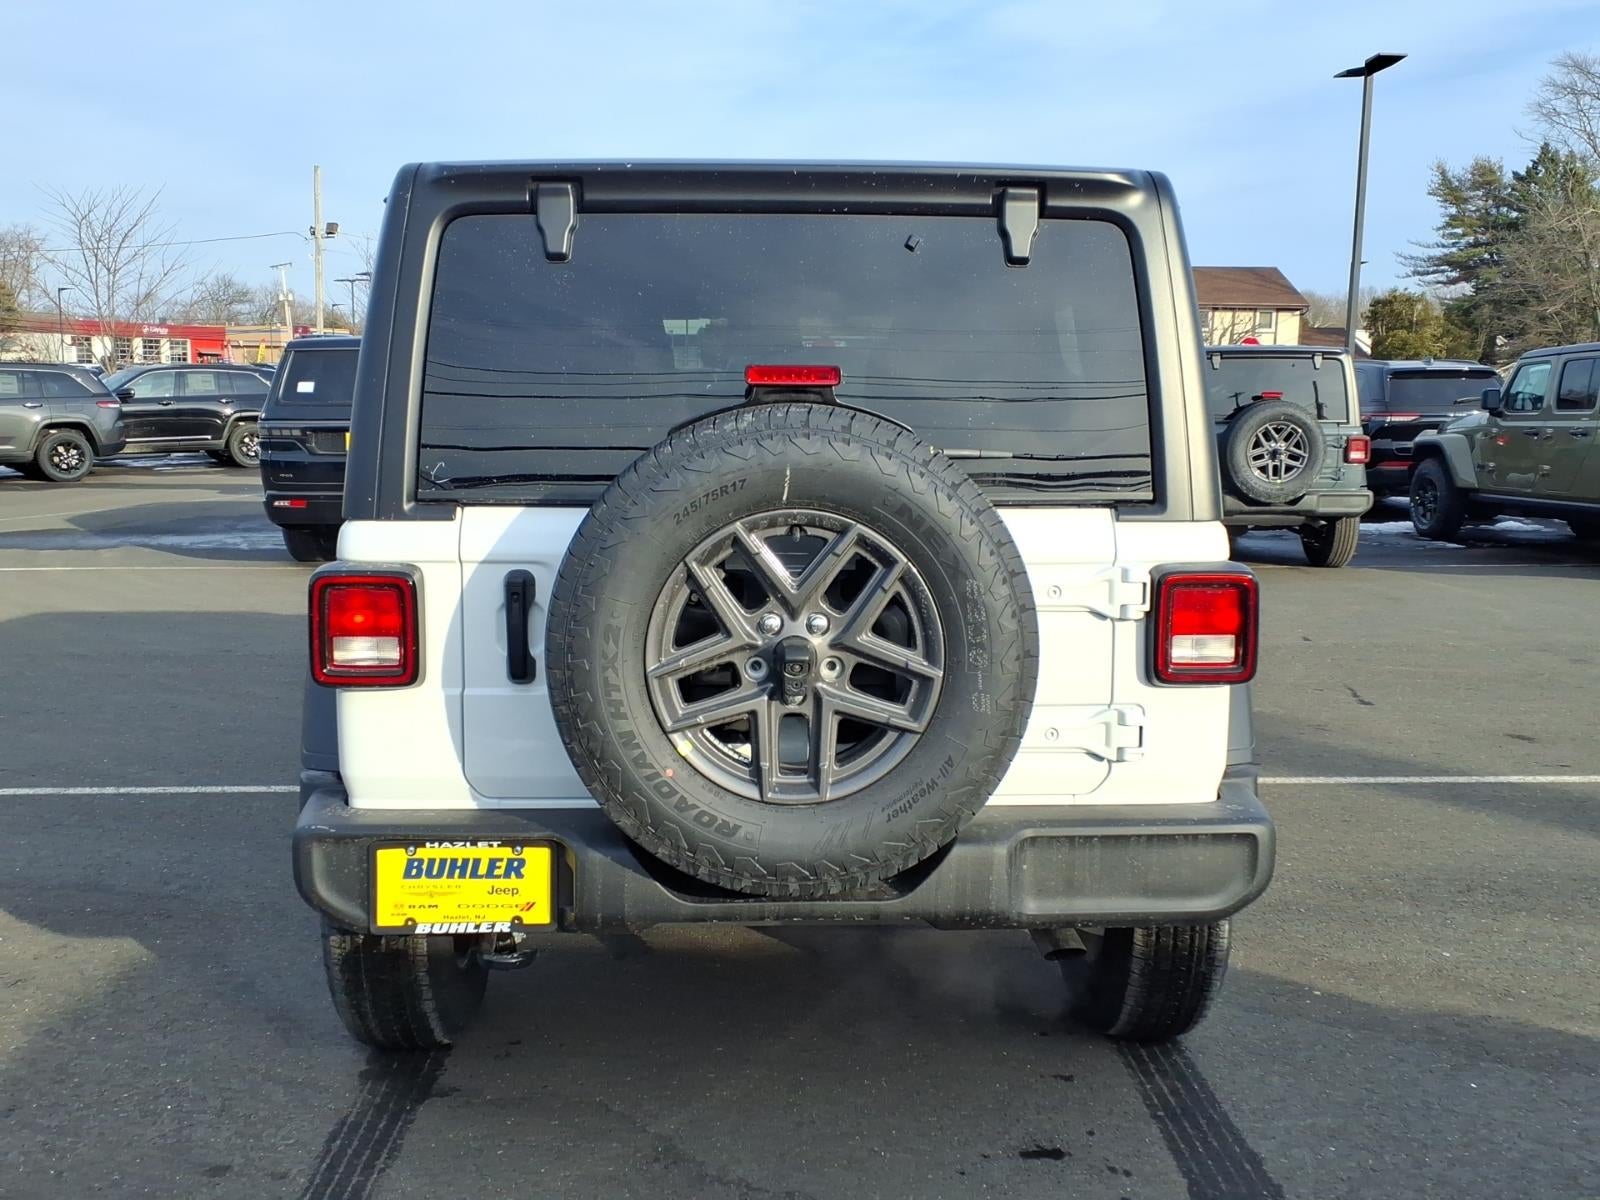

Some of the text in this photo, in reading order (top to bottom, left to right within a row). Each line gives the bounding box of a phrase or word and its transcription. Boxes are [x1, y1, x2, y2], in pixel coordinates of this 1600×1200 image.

[672, 477, 747, 527] 245/75R17
[600, 623, 742, 838] ROADIAN HTX2
[885, 753, 955, 823] All-Weather
[403, 857, 527, 880] BUHLER
[487, 885, 520, 897] Jeep
[414, 921, 511, 934] BUHLER
